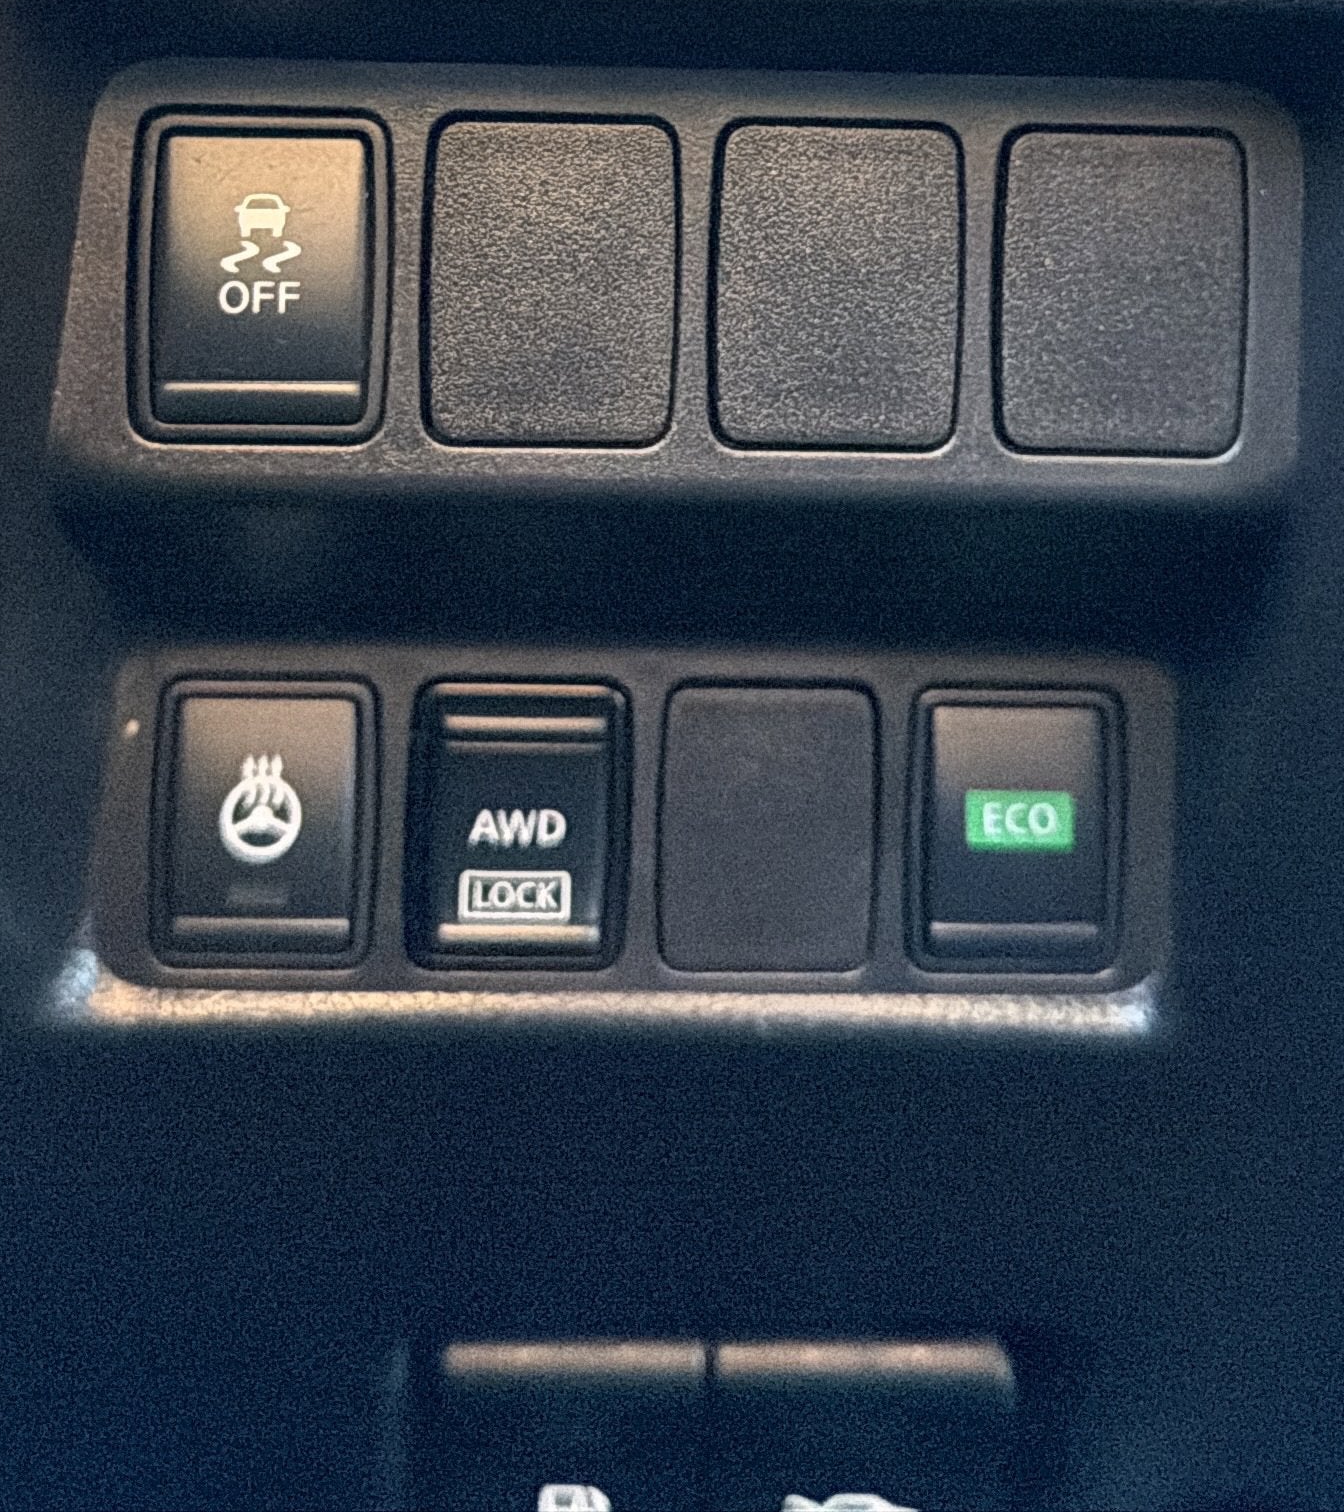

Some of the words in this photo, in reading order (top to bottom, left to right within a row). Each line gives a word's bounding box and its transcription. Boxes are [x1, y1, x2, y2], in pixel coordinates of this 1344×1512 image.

[218, 280, 301, 314] OFF
[467, 808, 567, 849] AWD
[982, 801, 1058, 837] ECO
[471, 880, 558, 910] LOCK
